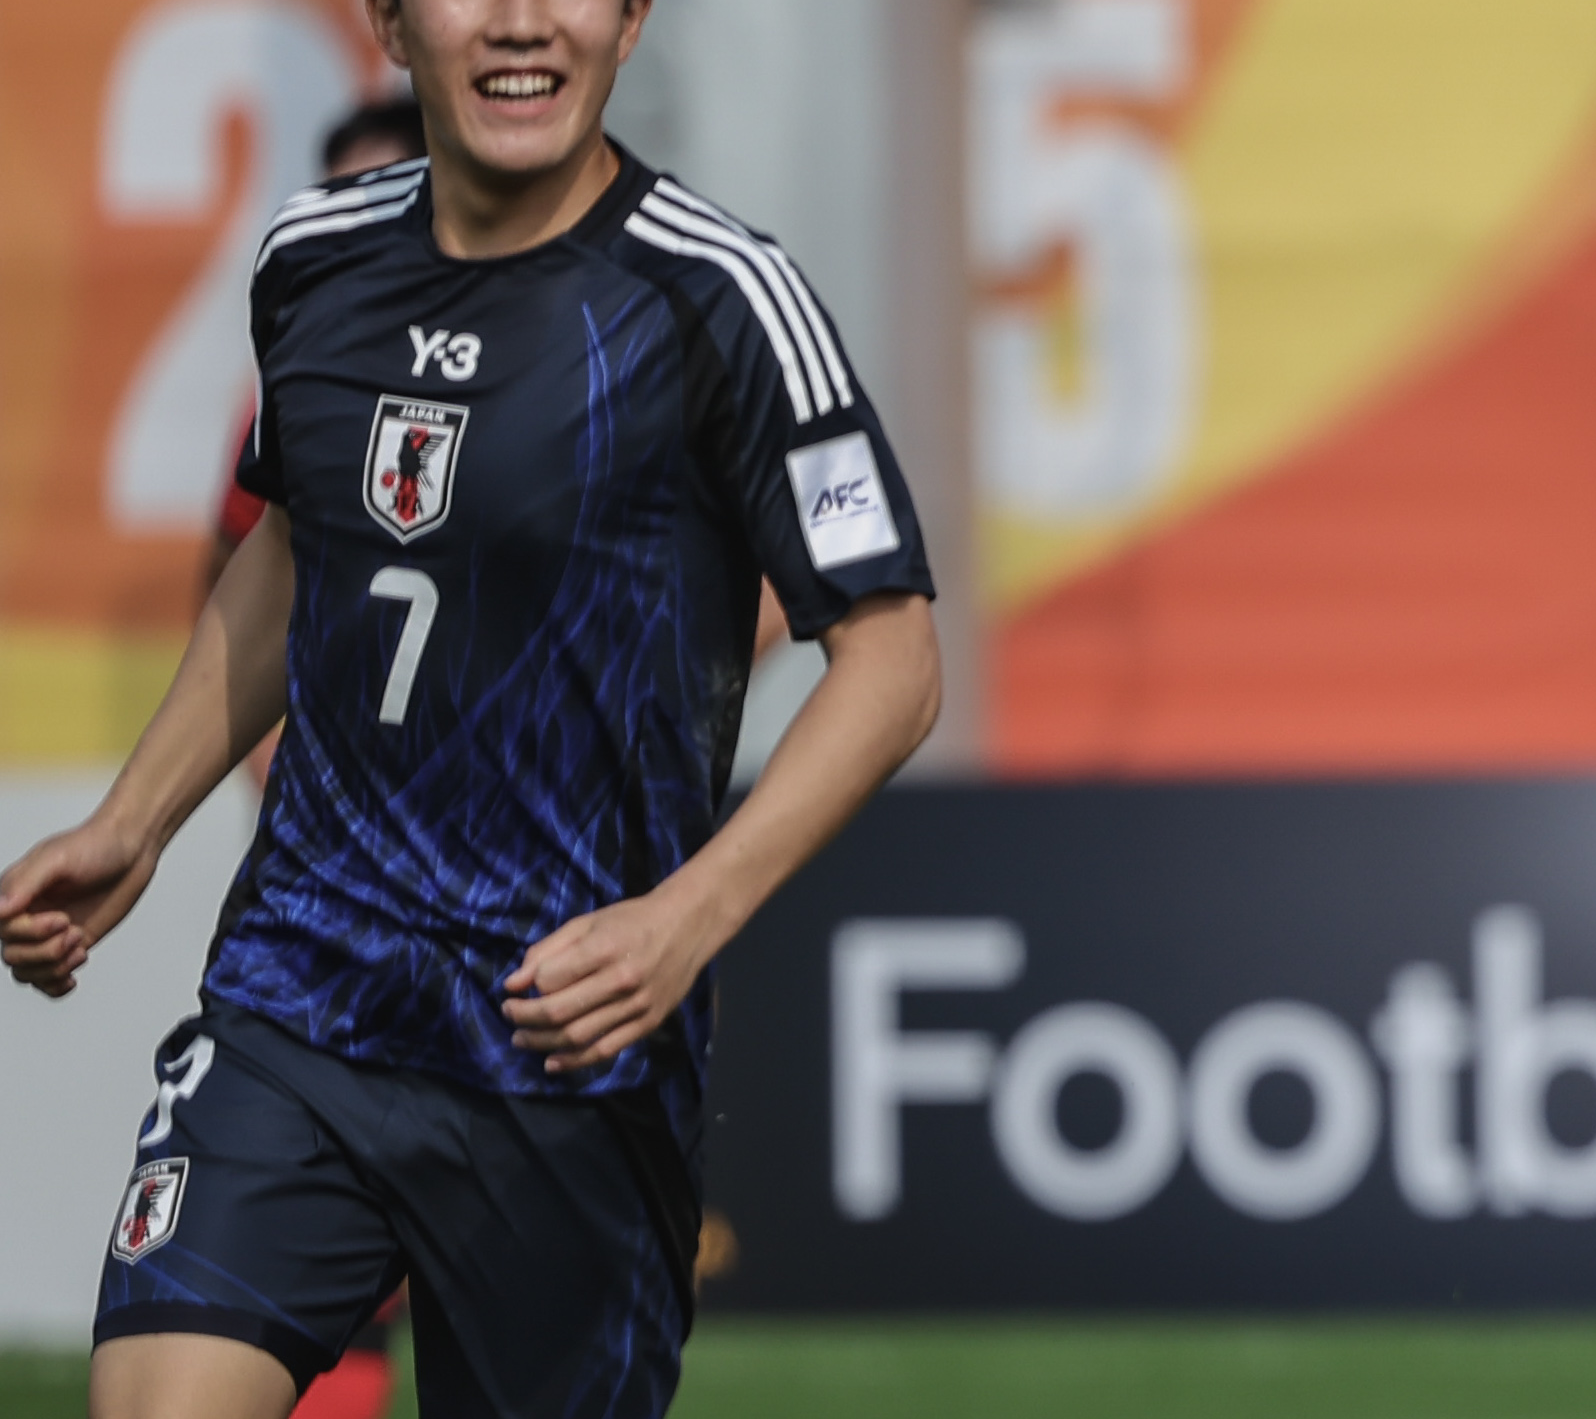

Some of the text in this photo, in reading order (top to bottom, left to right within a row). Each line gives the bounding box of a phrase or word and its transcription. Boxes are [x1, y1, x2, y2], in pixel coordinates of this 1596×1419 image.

[408, 324, 484, 382] Y-3
[399, 404, 447, 425] JAPAN
[810, 475, 871, 519] AFC
[369, 565, 440, 726] 7
[138, 1034, 216, 1149] 7
